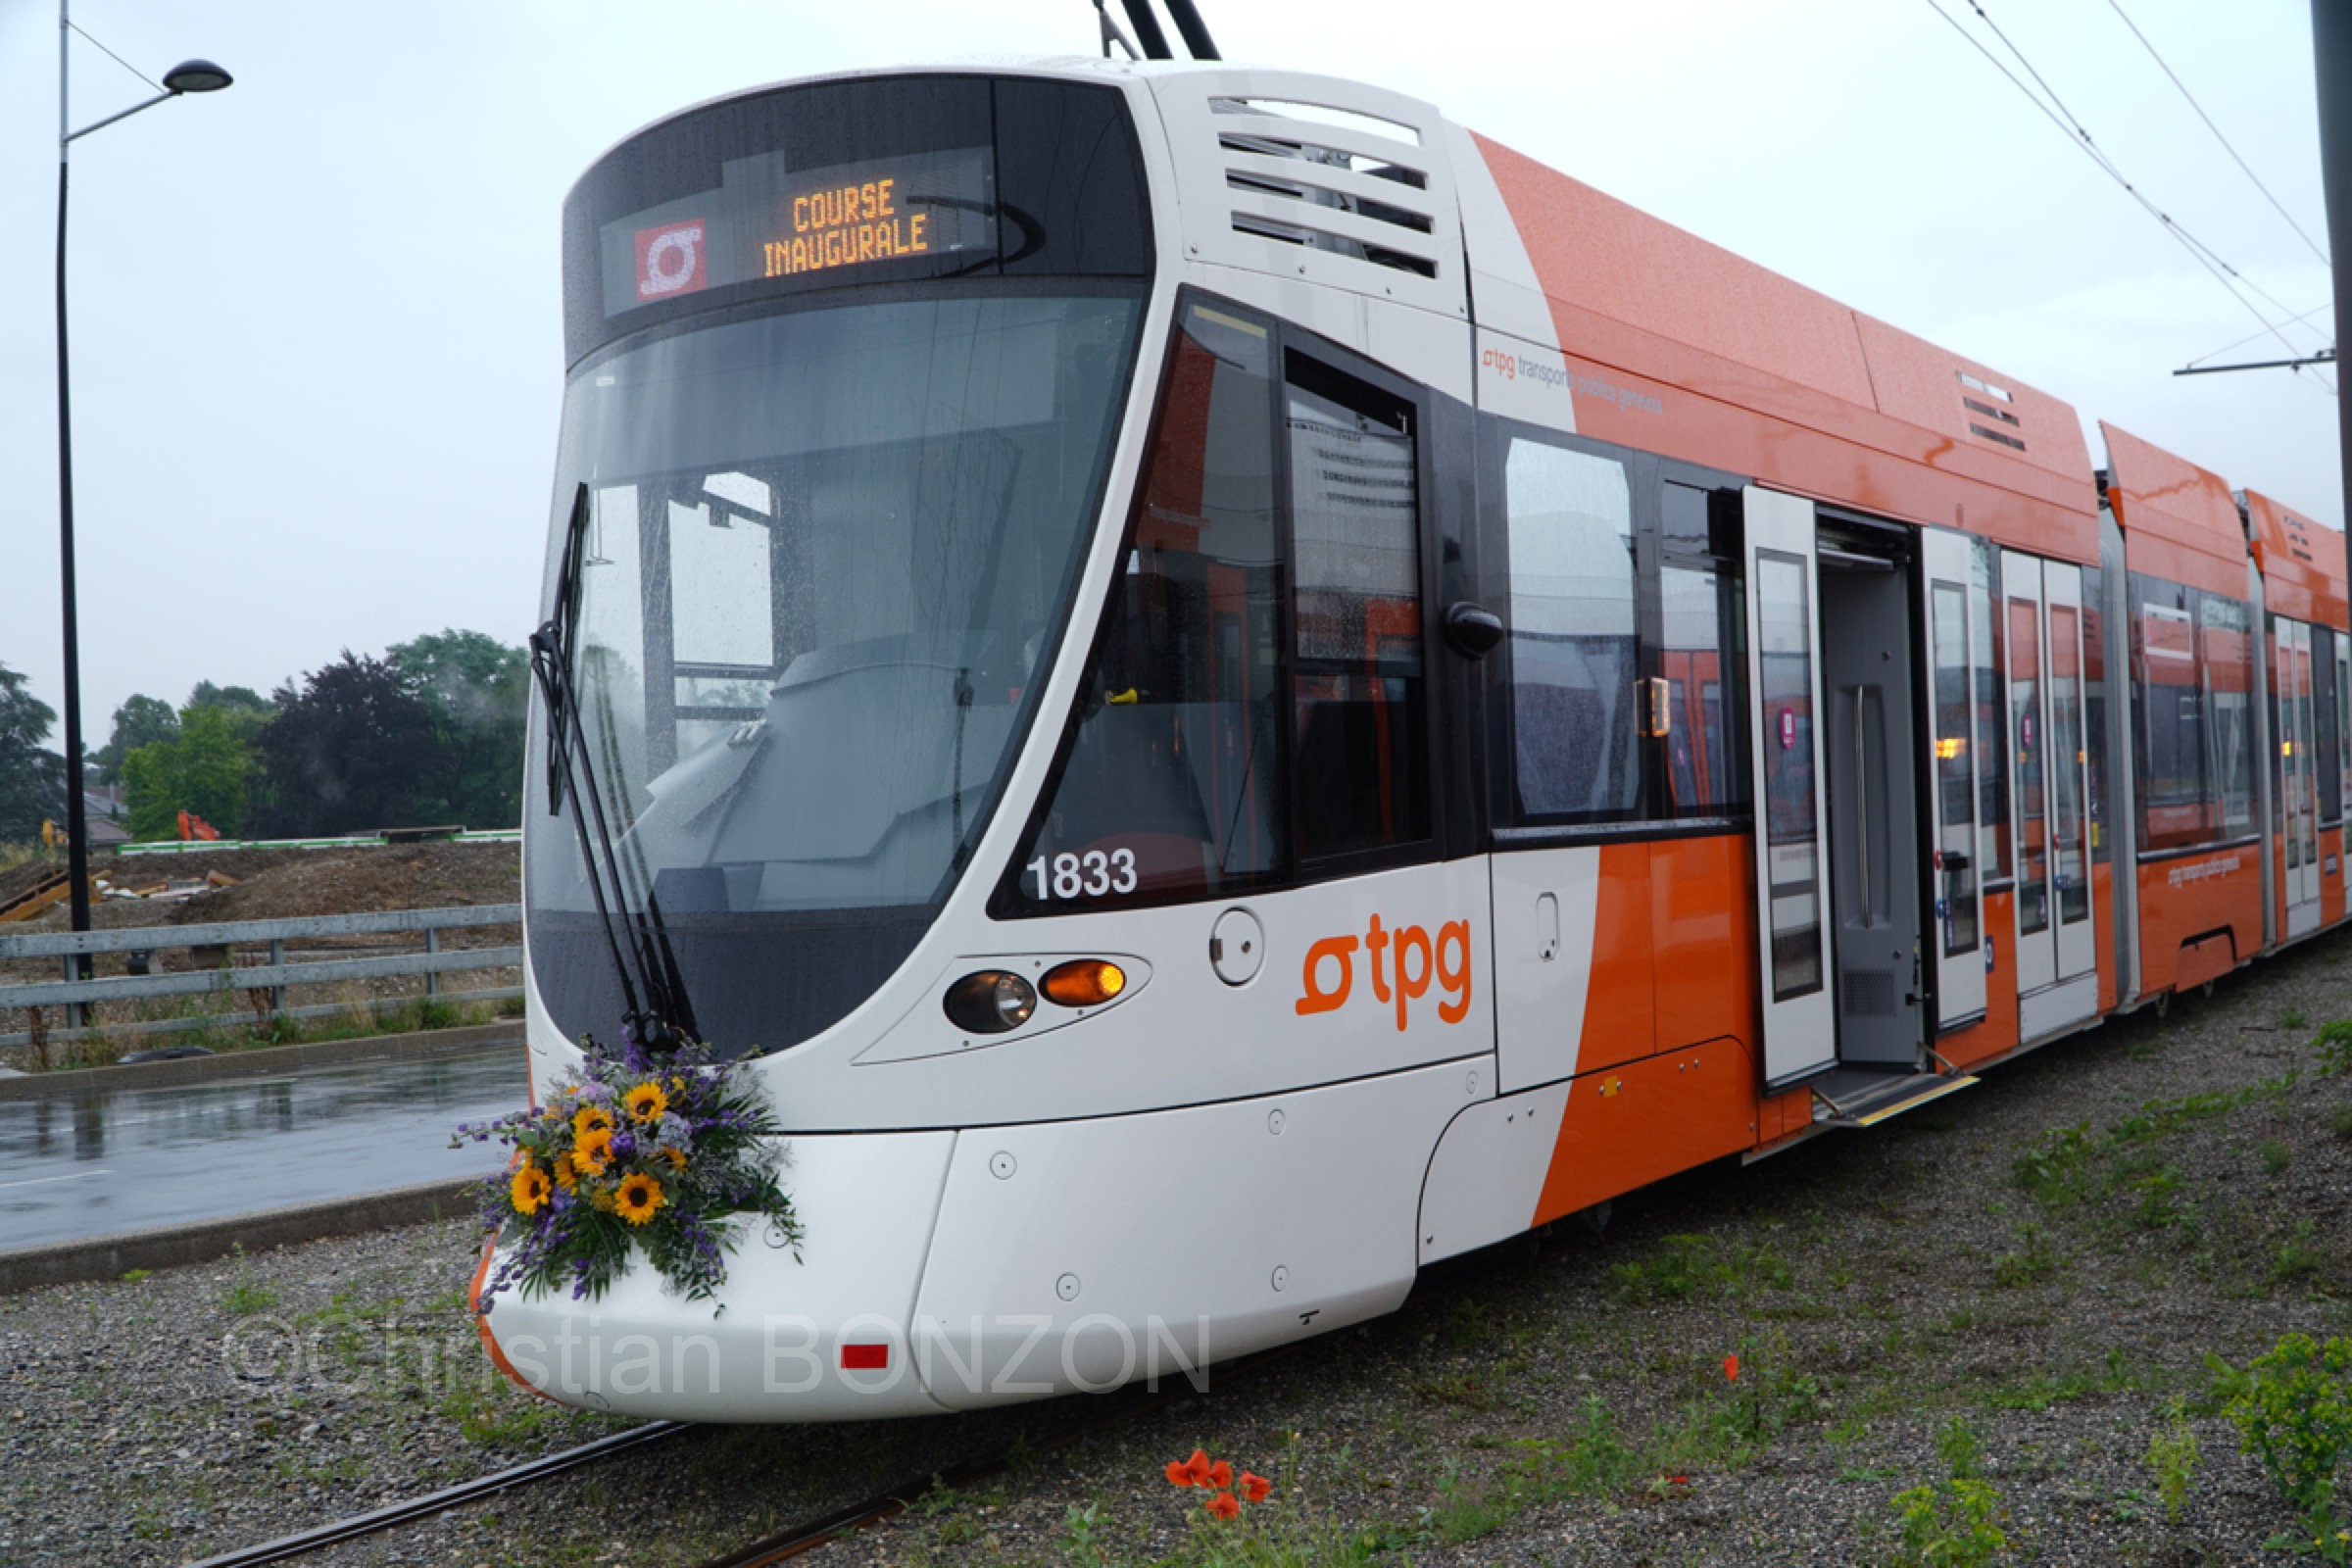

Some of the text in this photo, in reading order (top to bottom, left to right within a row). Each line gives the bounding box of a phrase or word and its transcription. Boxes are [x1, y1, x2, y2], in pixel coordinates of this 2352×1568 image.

[793, 178, 895, 232] COURSE
[763, 213, 928, 278] INAUGURALE
[1026, 848, 1138, 901] 1833
